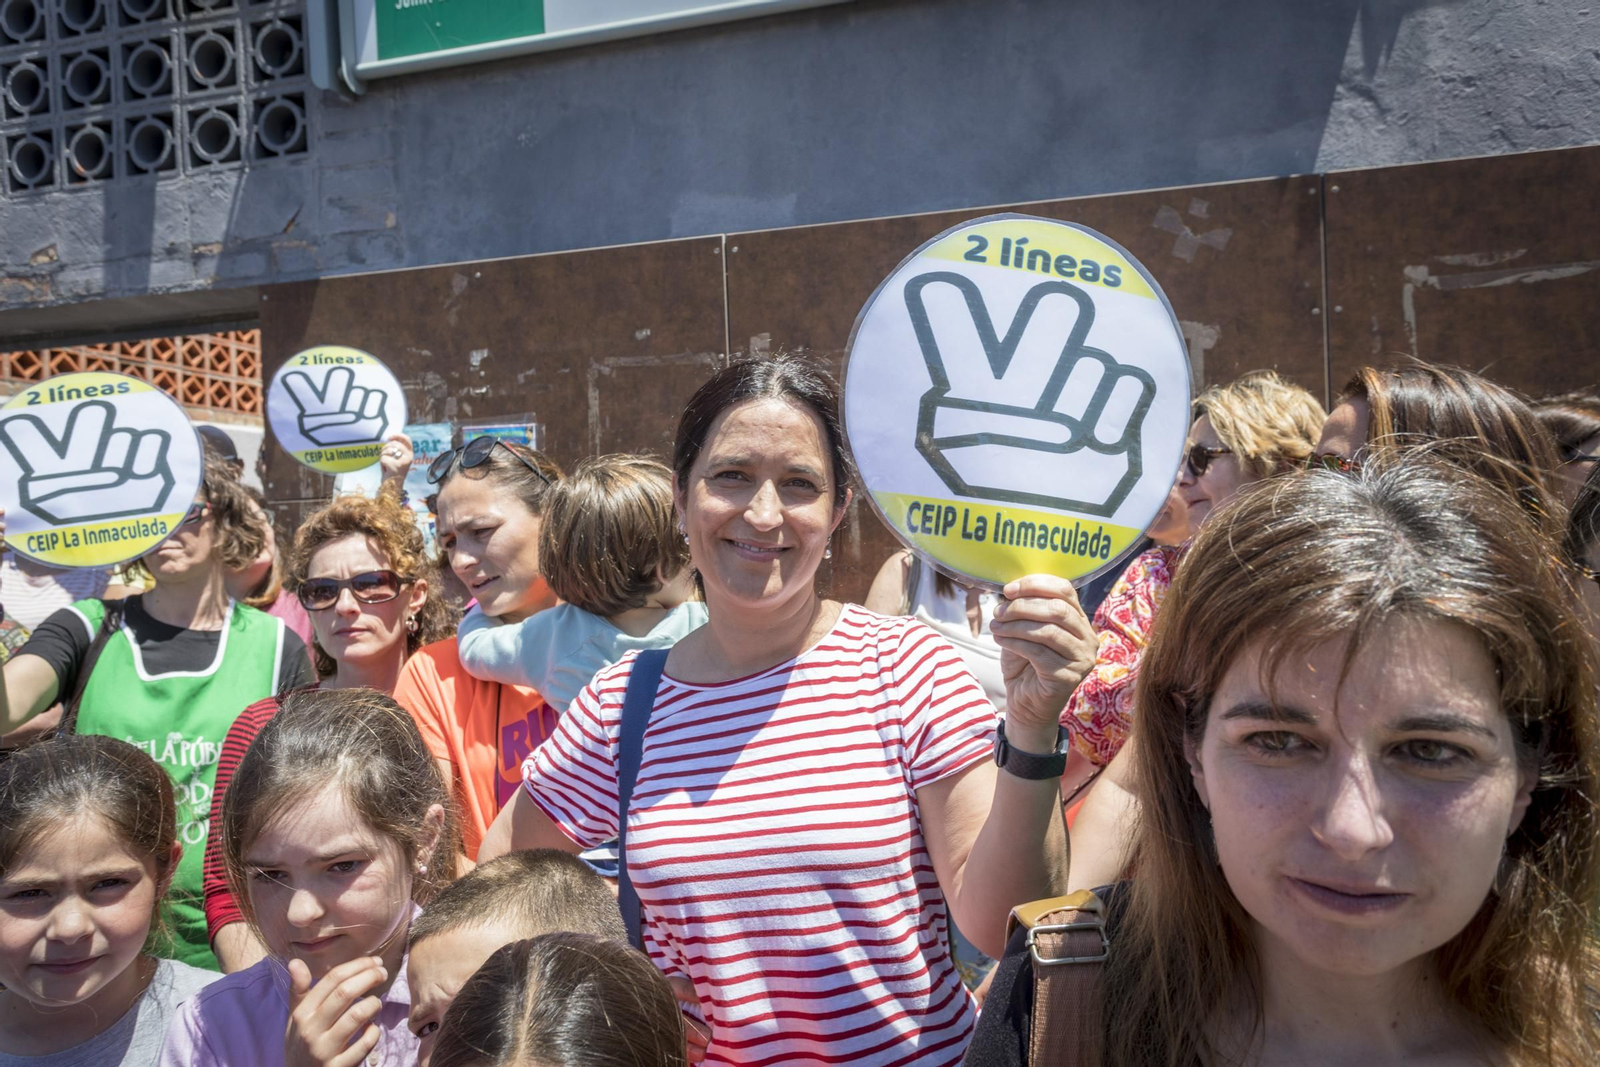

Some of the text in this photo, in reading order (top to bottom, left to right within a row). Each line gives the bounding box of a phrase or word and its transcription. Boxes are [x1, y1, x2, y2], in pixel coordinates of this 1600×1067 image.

[963, 234, 1122, 288] 2 líneas
[300, 353, 364, 366] 2 líneas
[27, 382, 130, 406] 2 líneas
[304, 451, 323, 464] CEIP
[325, 449, 335, 462] La
[27, 518, 168, 554] CEIP La Inmaculada
[906, 501, 1112, 560] CEIP La Inmaculada
[502, 703, 559, 772] RU
